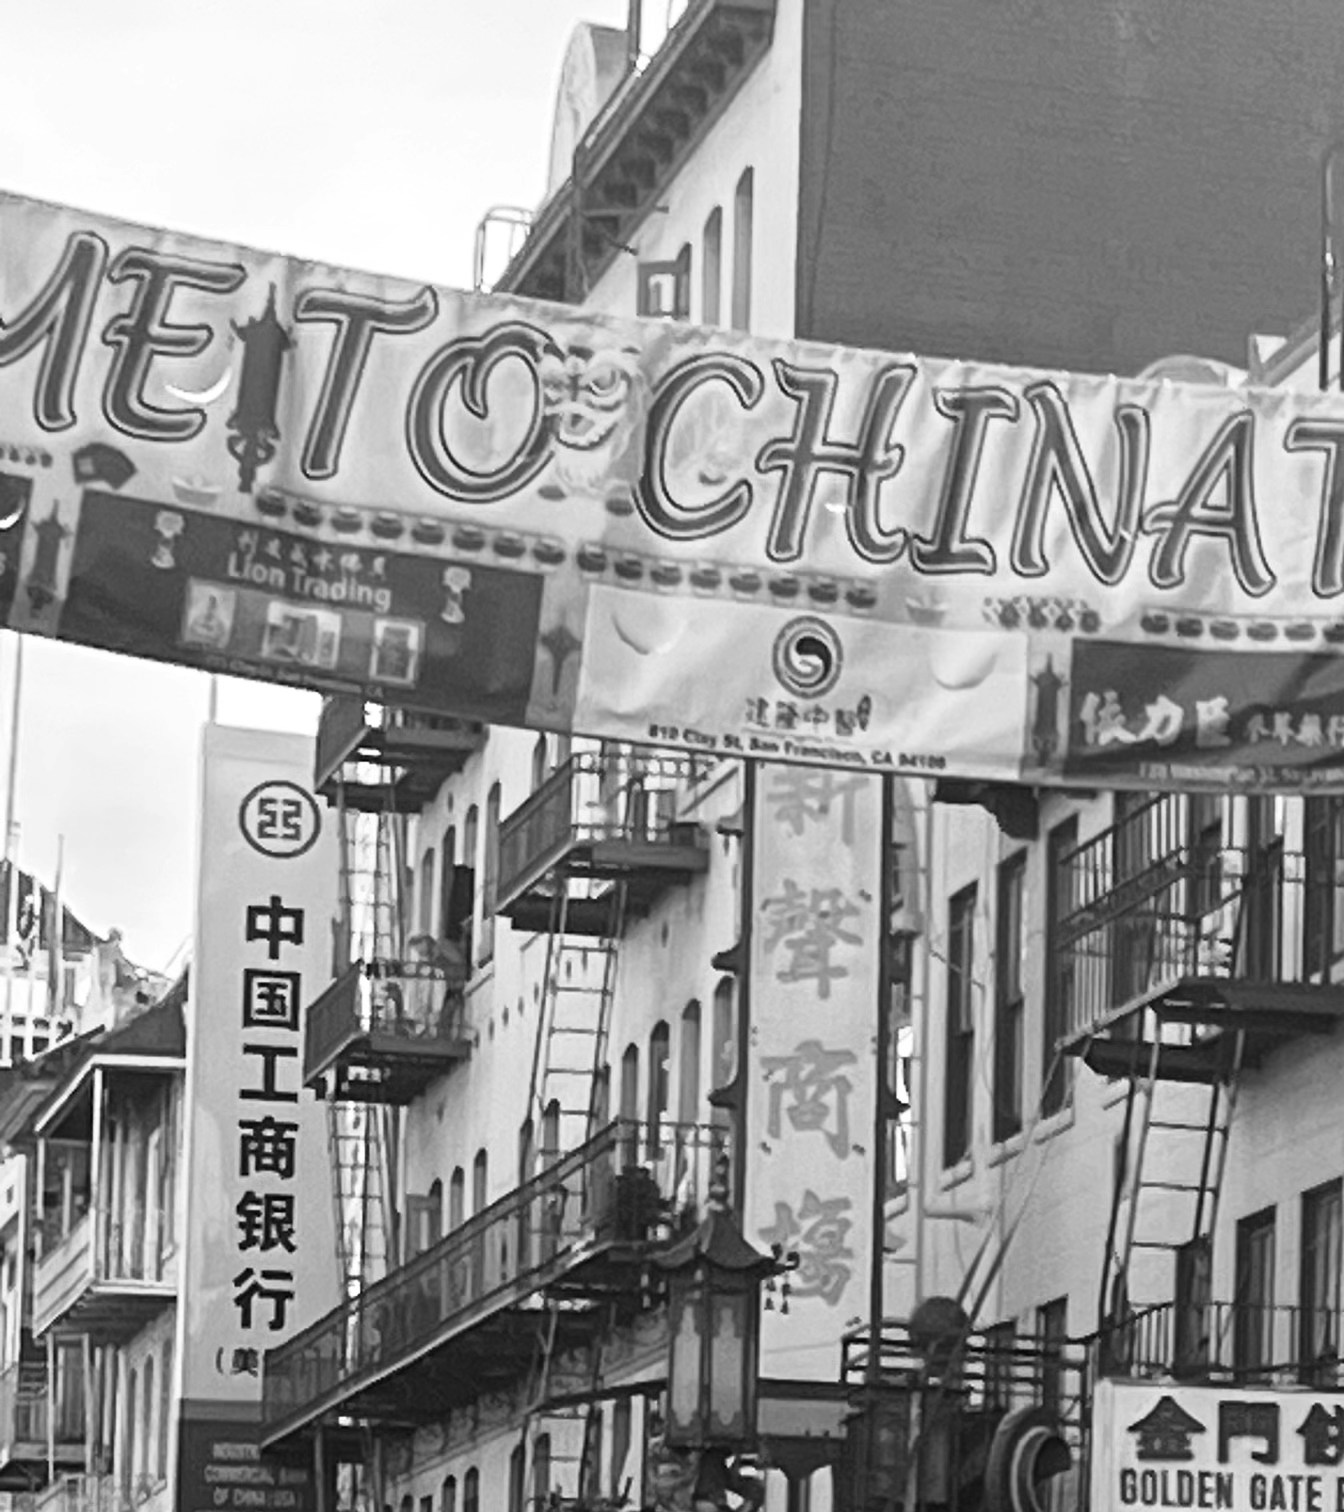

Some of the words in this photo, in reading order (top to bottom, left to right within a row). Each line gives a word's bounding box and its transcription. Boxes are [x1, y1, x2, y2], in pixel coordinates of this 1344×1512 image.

[294, 284, 562, 503] TO
[228, 549, 287, 588] Lion
[291, 564, 392, 613] Trading
[231, 895, 305, 1332] 中国工商银行
[1120, 1468, 1234, 1509] GOLDEN
[1250, 1474, 1323, 1512] GATE
